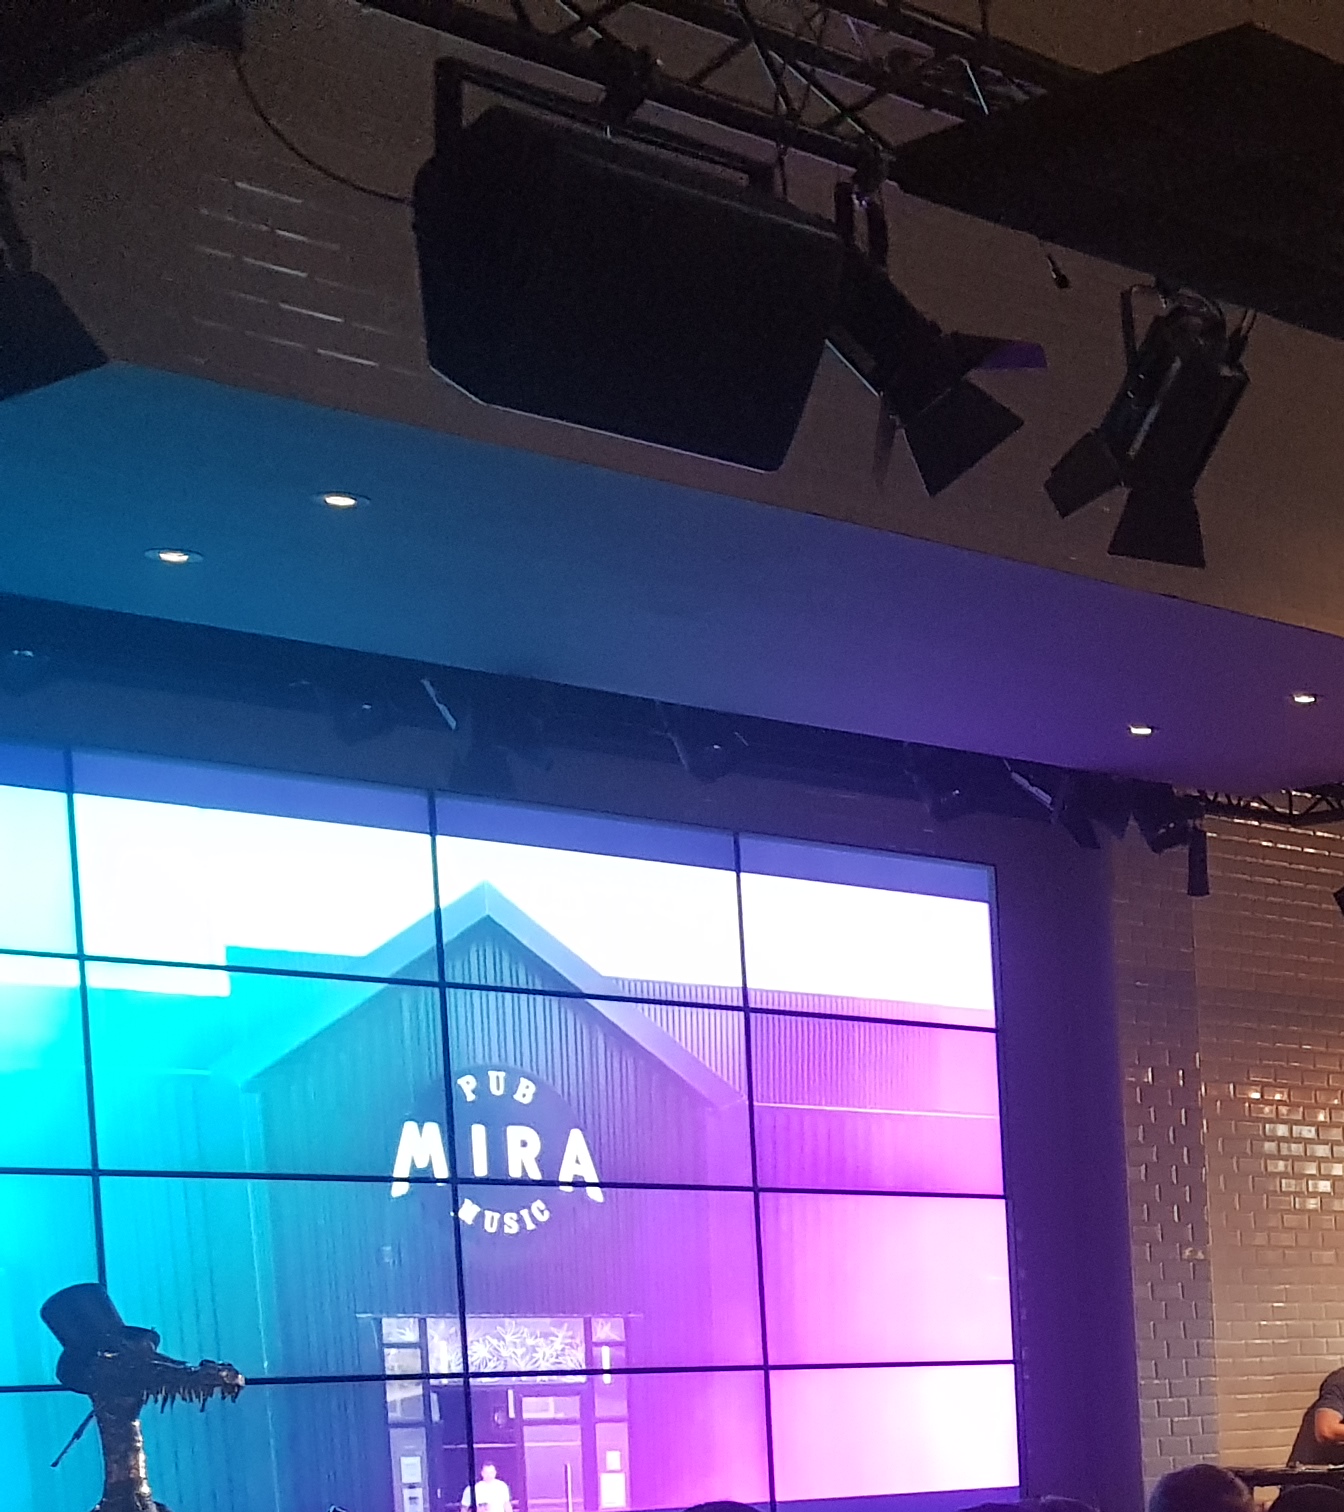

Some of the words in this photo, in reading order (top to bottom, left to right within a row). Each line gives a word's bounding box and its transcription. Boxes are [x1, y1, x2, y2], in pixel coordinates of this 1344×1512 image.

[457, 1070, 537, 1105] PUB
[391, 1121, 604, 1203] MIRA
[457, 1198, 550, 1235] MUSIC
